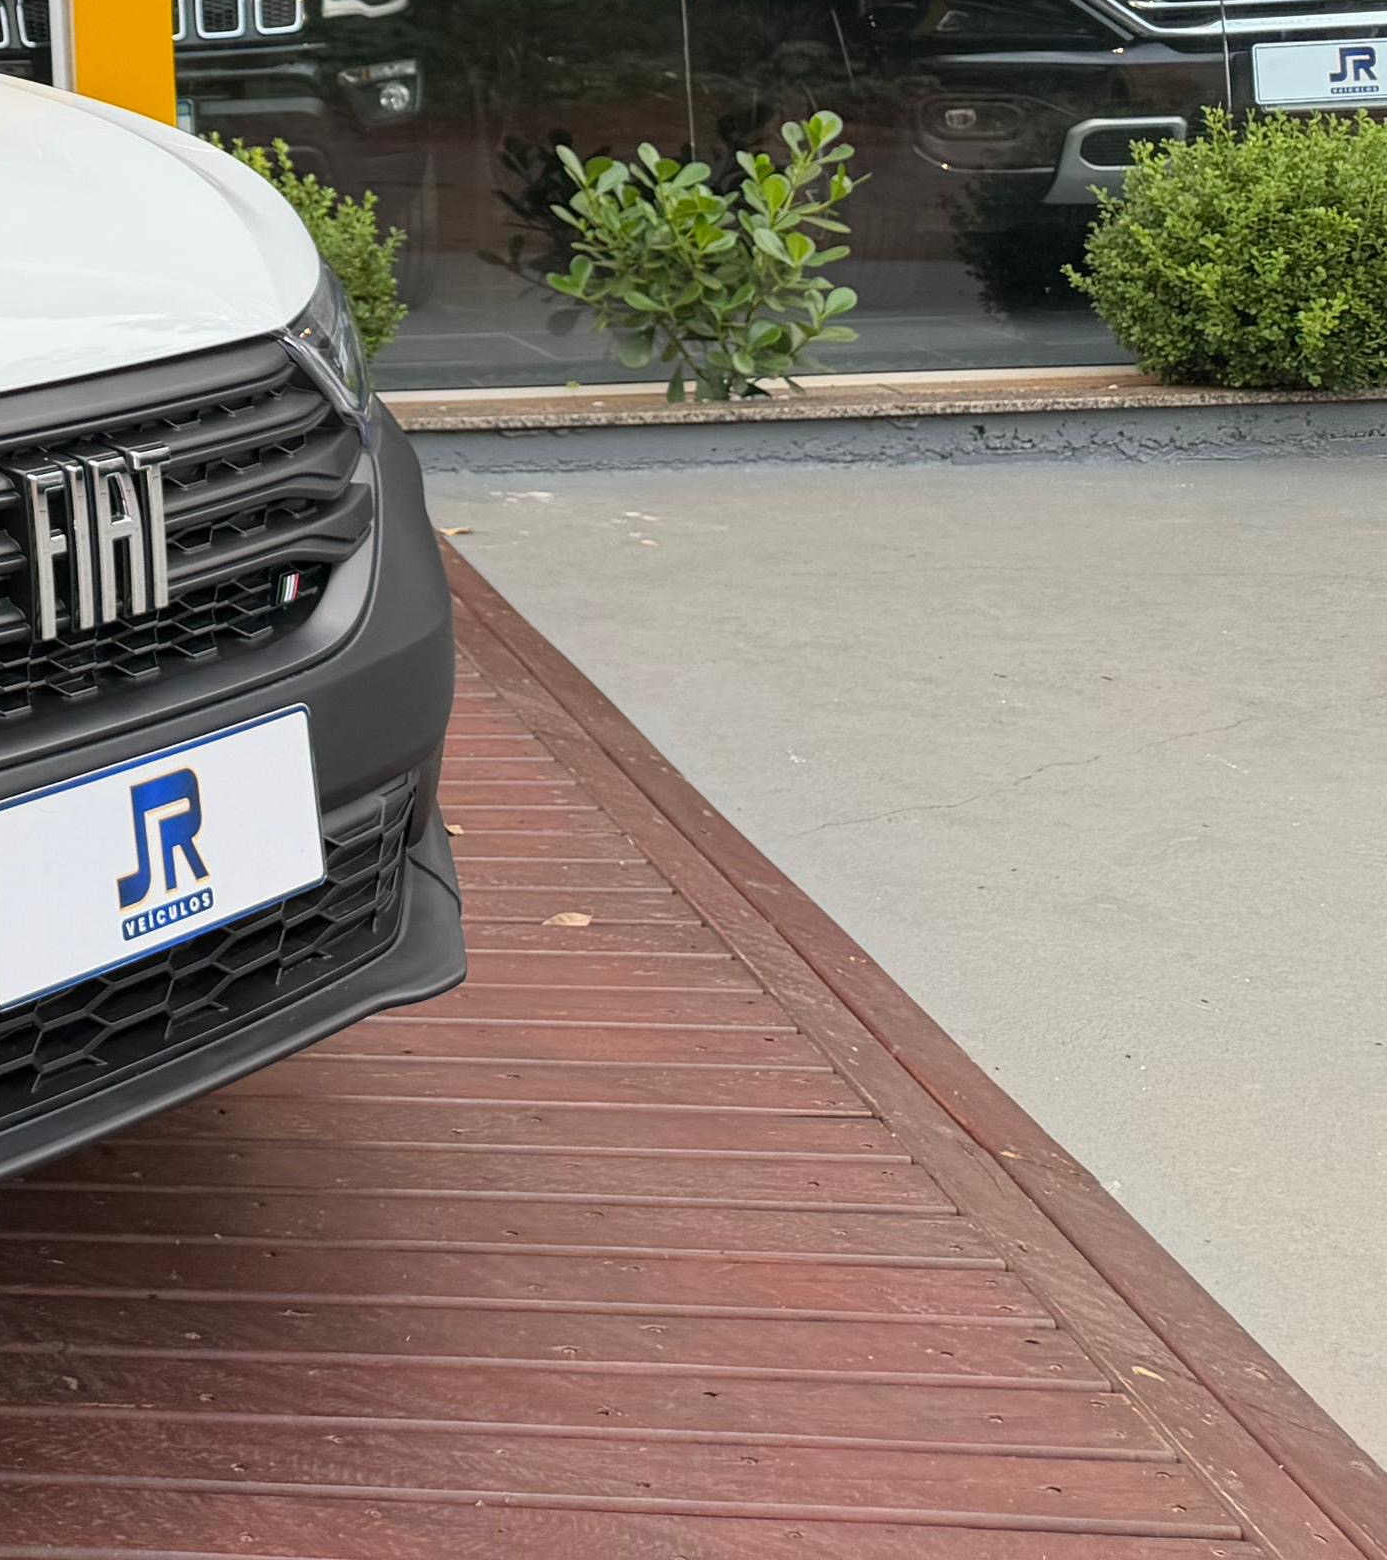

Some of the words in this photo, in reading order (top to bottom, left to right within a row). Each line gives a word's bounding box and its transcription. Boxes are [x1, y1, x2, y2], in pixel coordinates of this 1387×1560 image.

[1329, 46, 1378, 83] JR
[26, 446, 171, 640] FIAT
[116, 766, 210, 911] JR
[125, 891, 212, 938] VEÍCULOS
